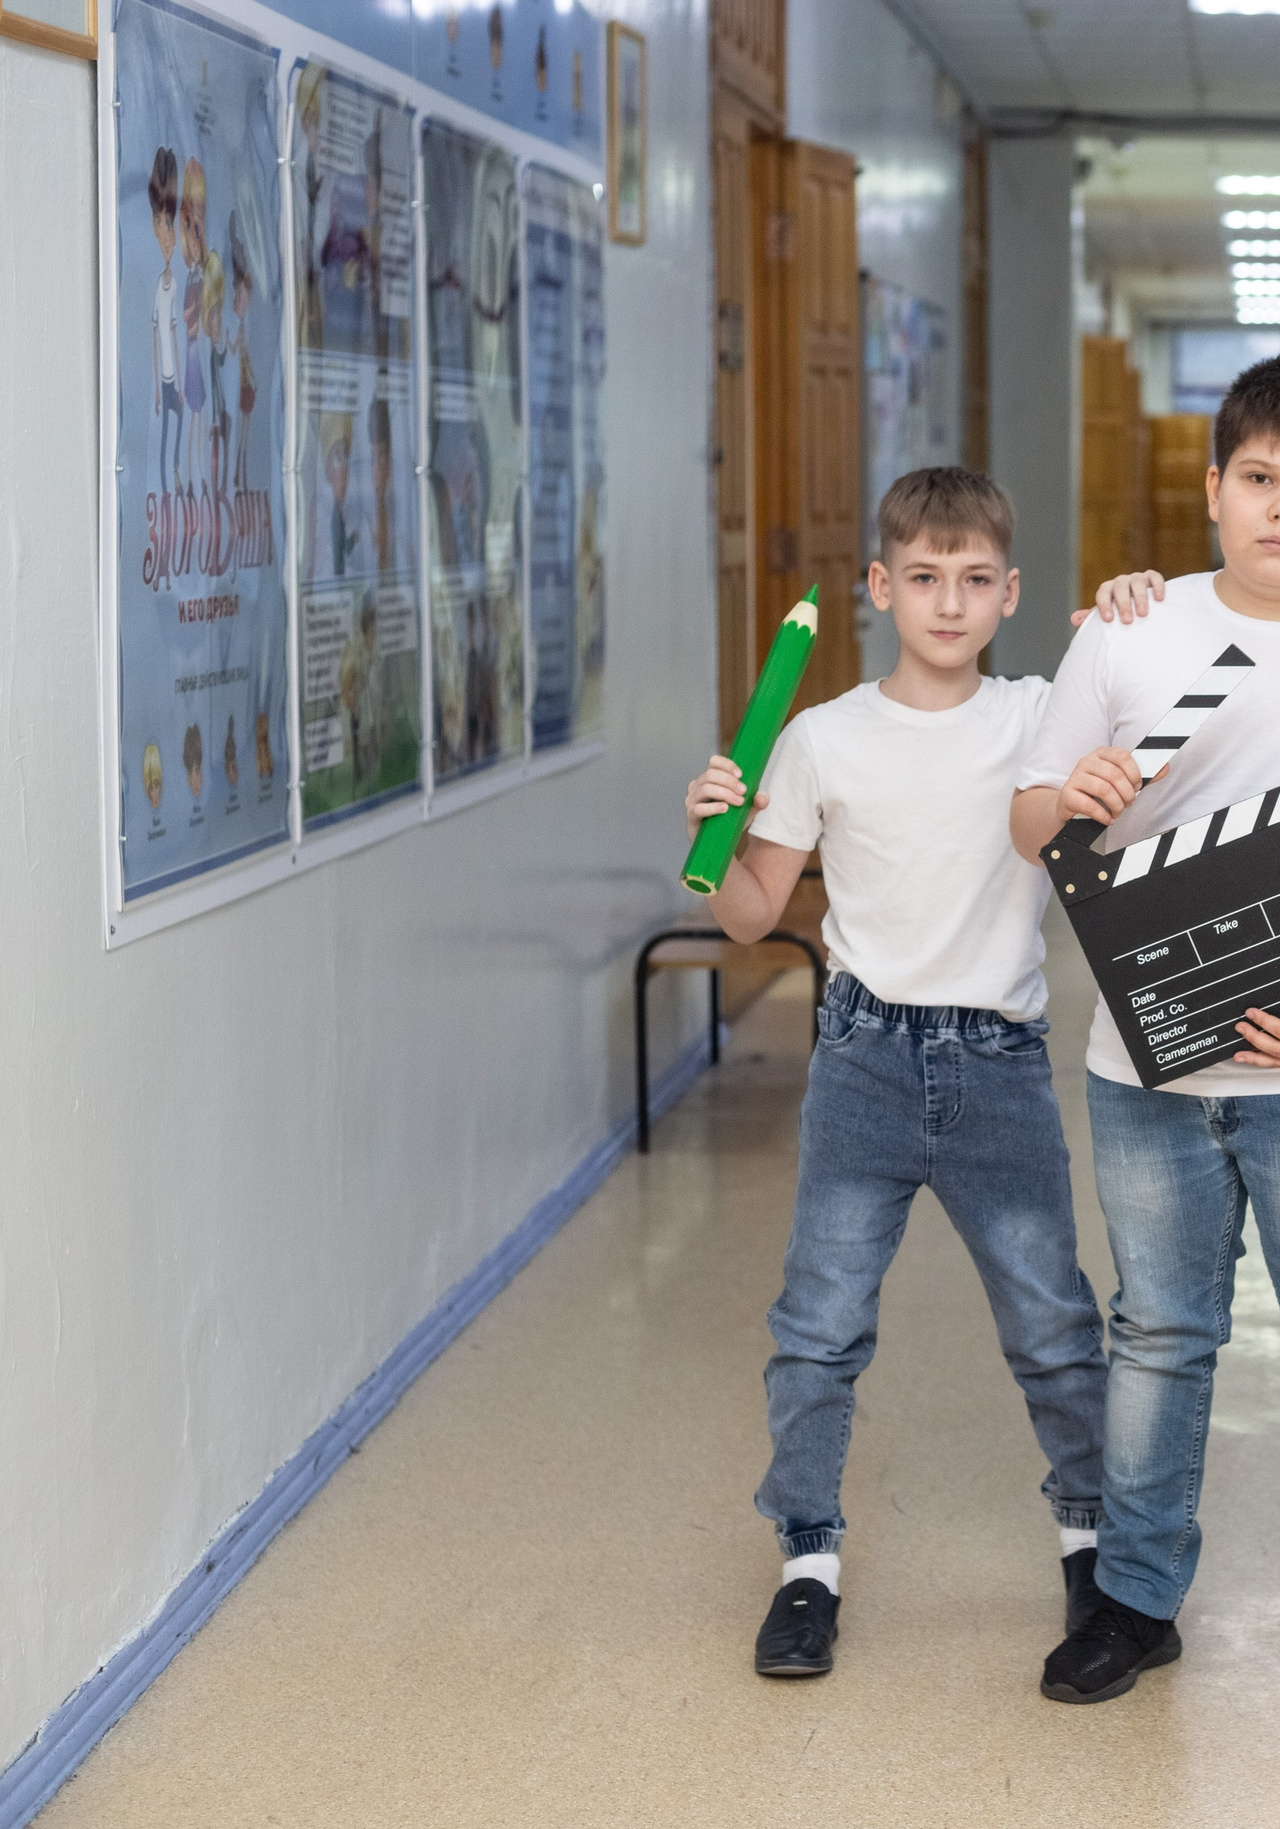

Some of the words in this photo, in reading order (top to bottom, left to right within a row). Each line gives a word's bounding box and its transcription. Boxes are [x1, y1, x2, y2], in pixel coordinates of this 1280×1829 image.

[178, 600, 186, 624] И
[188, 598, 204, 623] ЕГО
[1213, 918, 1239, 935] Take
[1136, 946, 1170, 966] Scene
[1131, 991, 1157, 1008] Date
[1139, 1009, 1168, 1027] Prod.
[1169, 1003, 1188, 1016] Co.
[1147, 1022, 1188, 1047] Director
[1155, 1033, 1219, 1065] Cameraman
